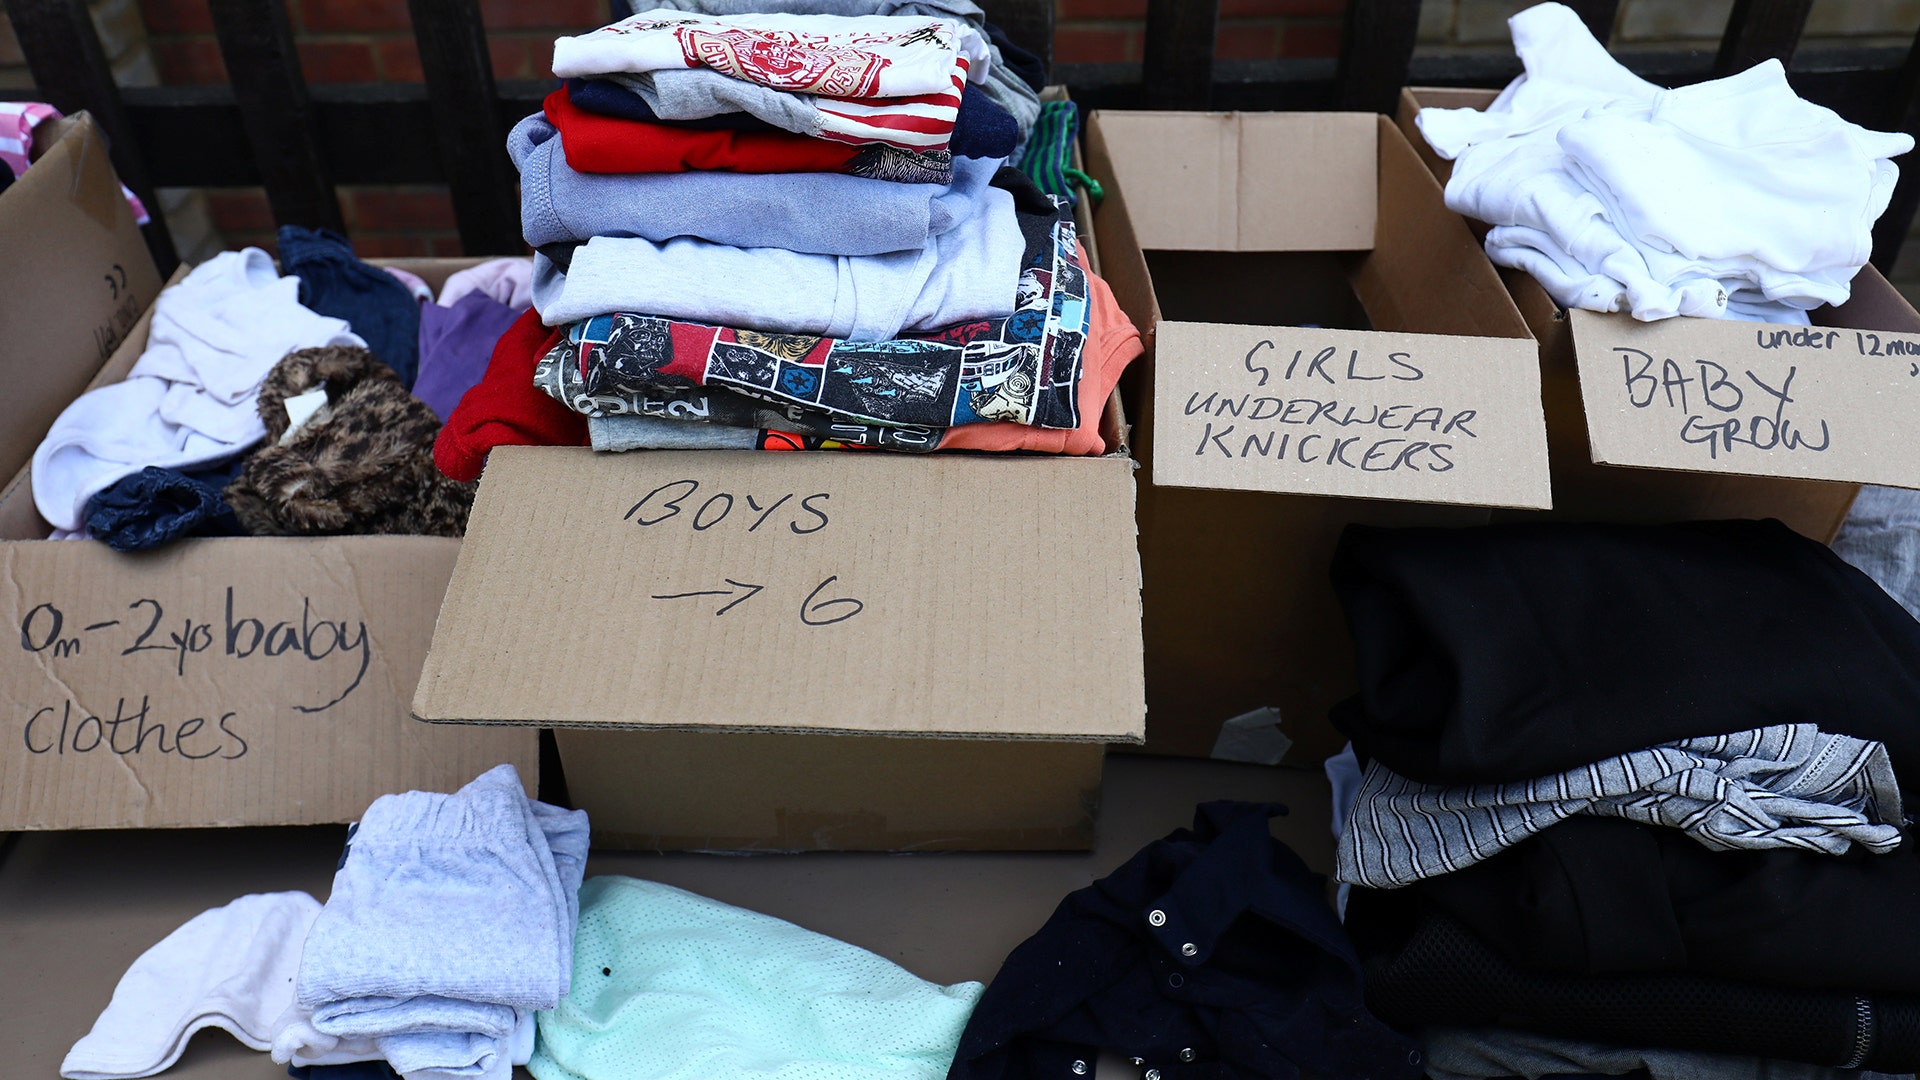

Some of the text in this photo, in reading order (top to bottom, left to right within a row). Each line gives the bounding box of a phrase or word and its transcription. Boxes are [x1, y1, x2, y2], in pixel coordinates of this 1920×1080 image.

[1245, 340, 1424, 387] GIRLS
[1757, 328, 1840, 350] under
[1184, 392, 1478, 438] UNDERWEAR
[1613, 347, 1797, 432] BABY
[1195, 422, 1454, 473] KNICKERS
[1681, 416, 1830, 460] GROW
[623, 479, 831, 535] BOYS
[799, 575, 864, 626] 6
[225, 586, 371, 714] baby
[24, 695, 248, 760] clothes
